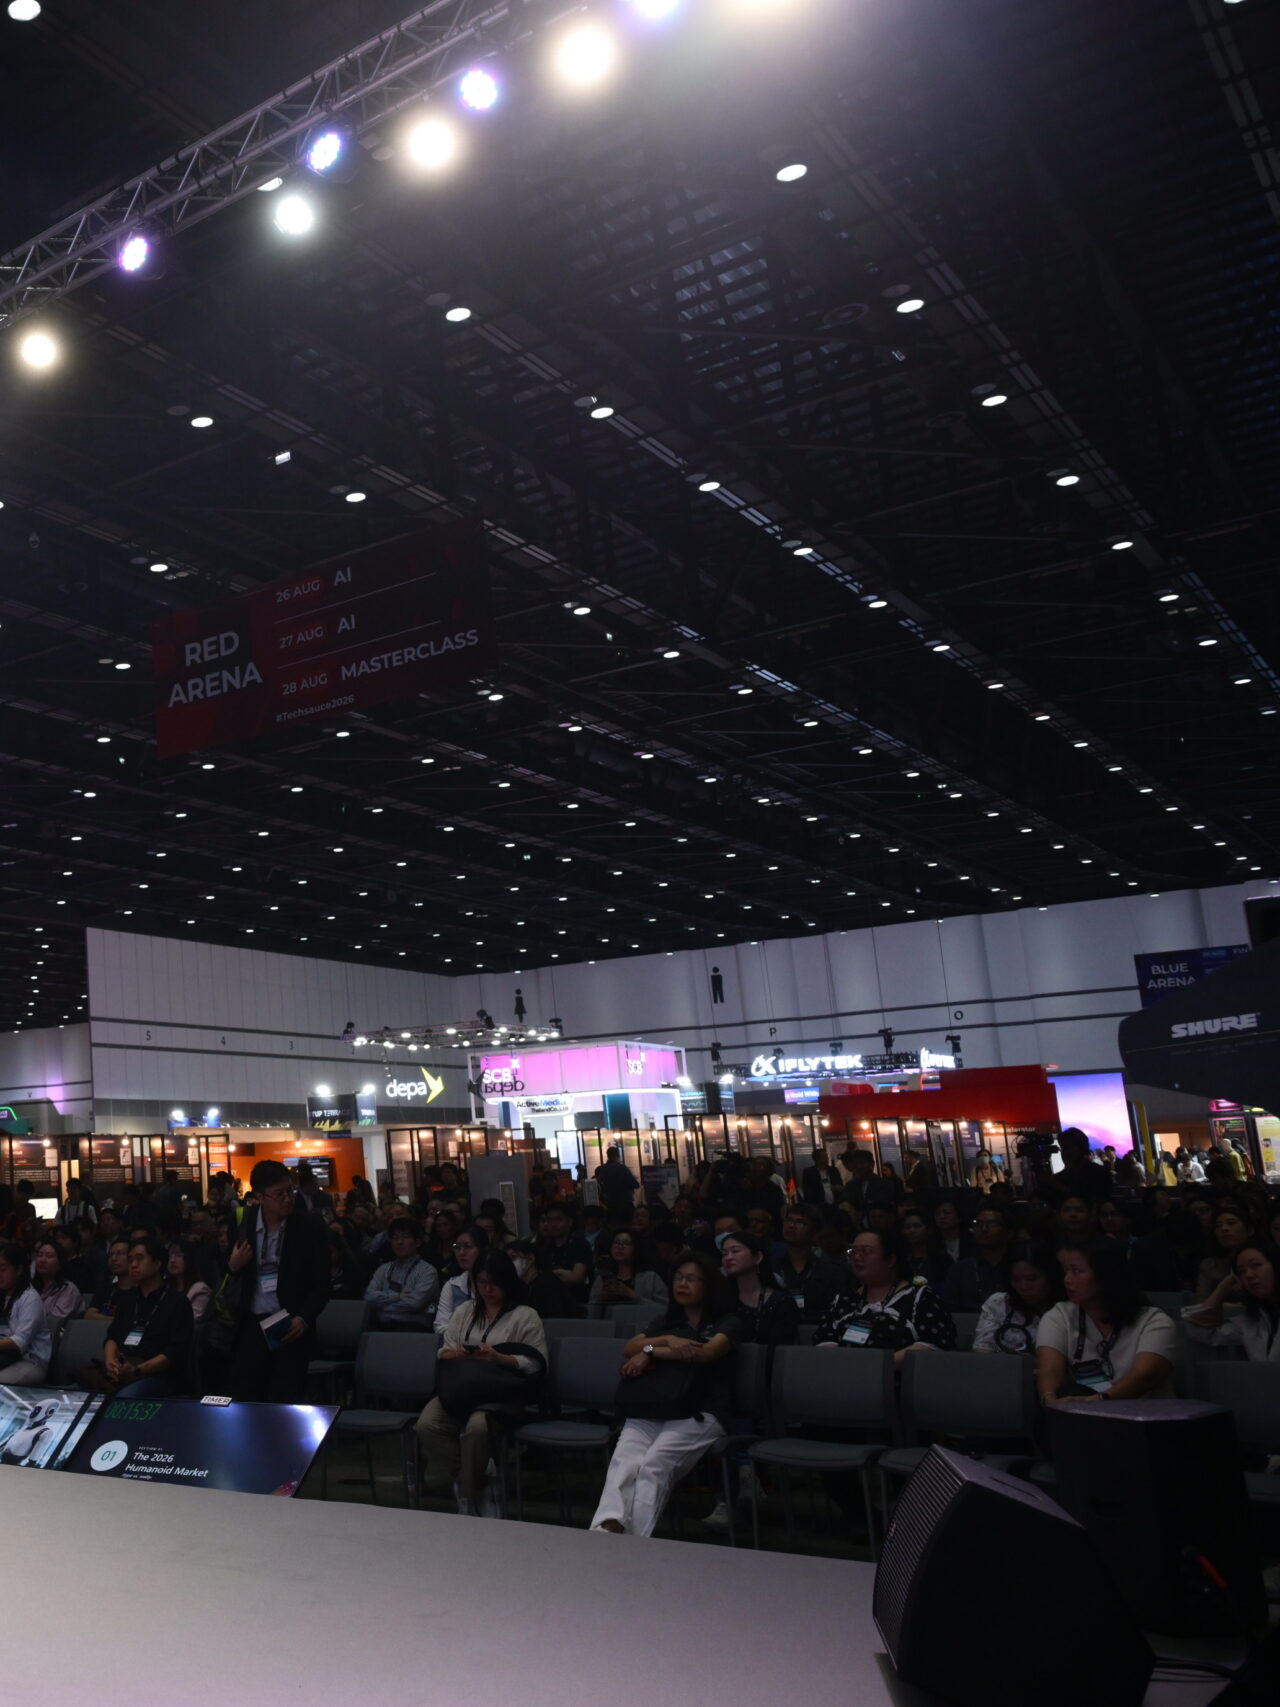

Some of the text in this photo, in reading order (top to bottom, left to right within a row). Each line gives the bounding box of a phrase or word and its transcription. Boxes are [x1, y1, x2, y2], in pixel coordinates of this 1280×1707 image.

[333, 567, 352, 587] AI
[275, 579, 320, 603] 26 AUG
[337, 614, 356, 633] AI
[279, 626, 324, 649] 27 AUG
[184, 630, 240, 667] RED
[341, 629, 479, 681] MASTERCLASS
[168, 661, 263, 708] ARENA
[282, 673, 328, 696] 28 AUG
[275, 694, 355, 722] #Techsauce2026
[1151, 962, 1190, 976] BLUE
[1146, 975, 1197, 990] ARENA
[770, 1027, 777, 1037] P
[1171, 1012, 1259, 1039] SHURE
[146, 1030, 152, 1041] 5
[221, 1036, 227, 1046] 4
[289, 1040, 294, 1051] 3
[482, 1067, 513, 1084] SCB
[386, 1079, 427, 1100] depa
[203, 1396, 231, 1404] TIMER
[101, 1450, 117, 1462] 01
[132, 1452, 175, 1463] The 2026
[124, 1463, 209, 1478] Humanoid Market
